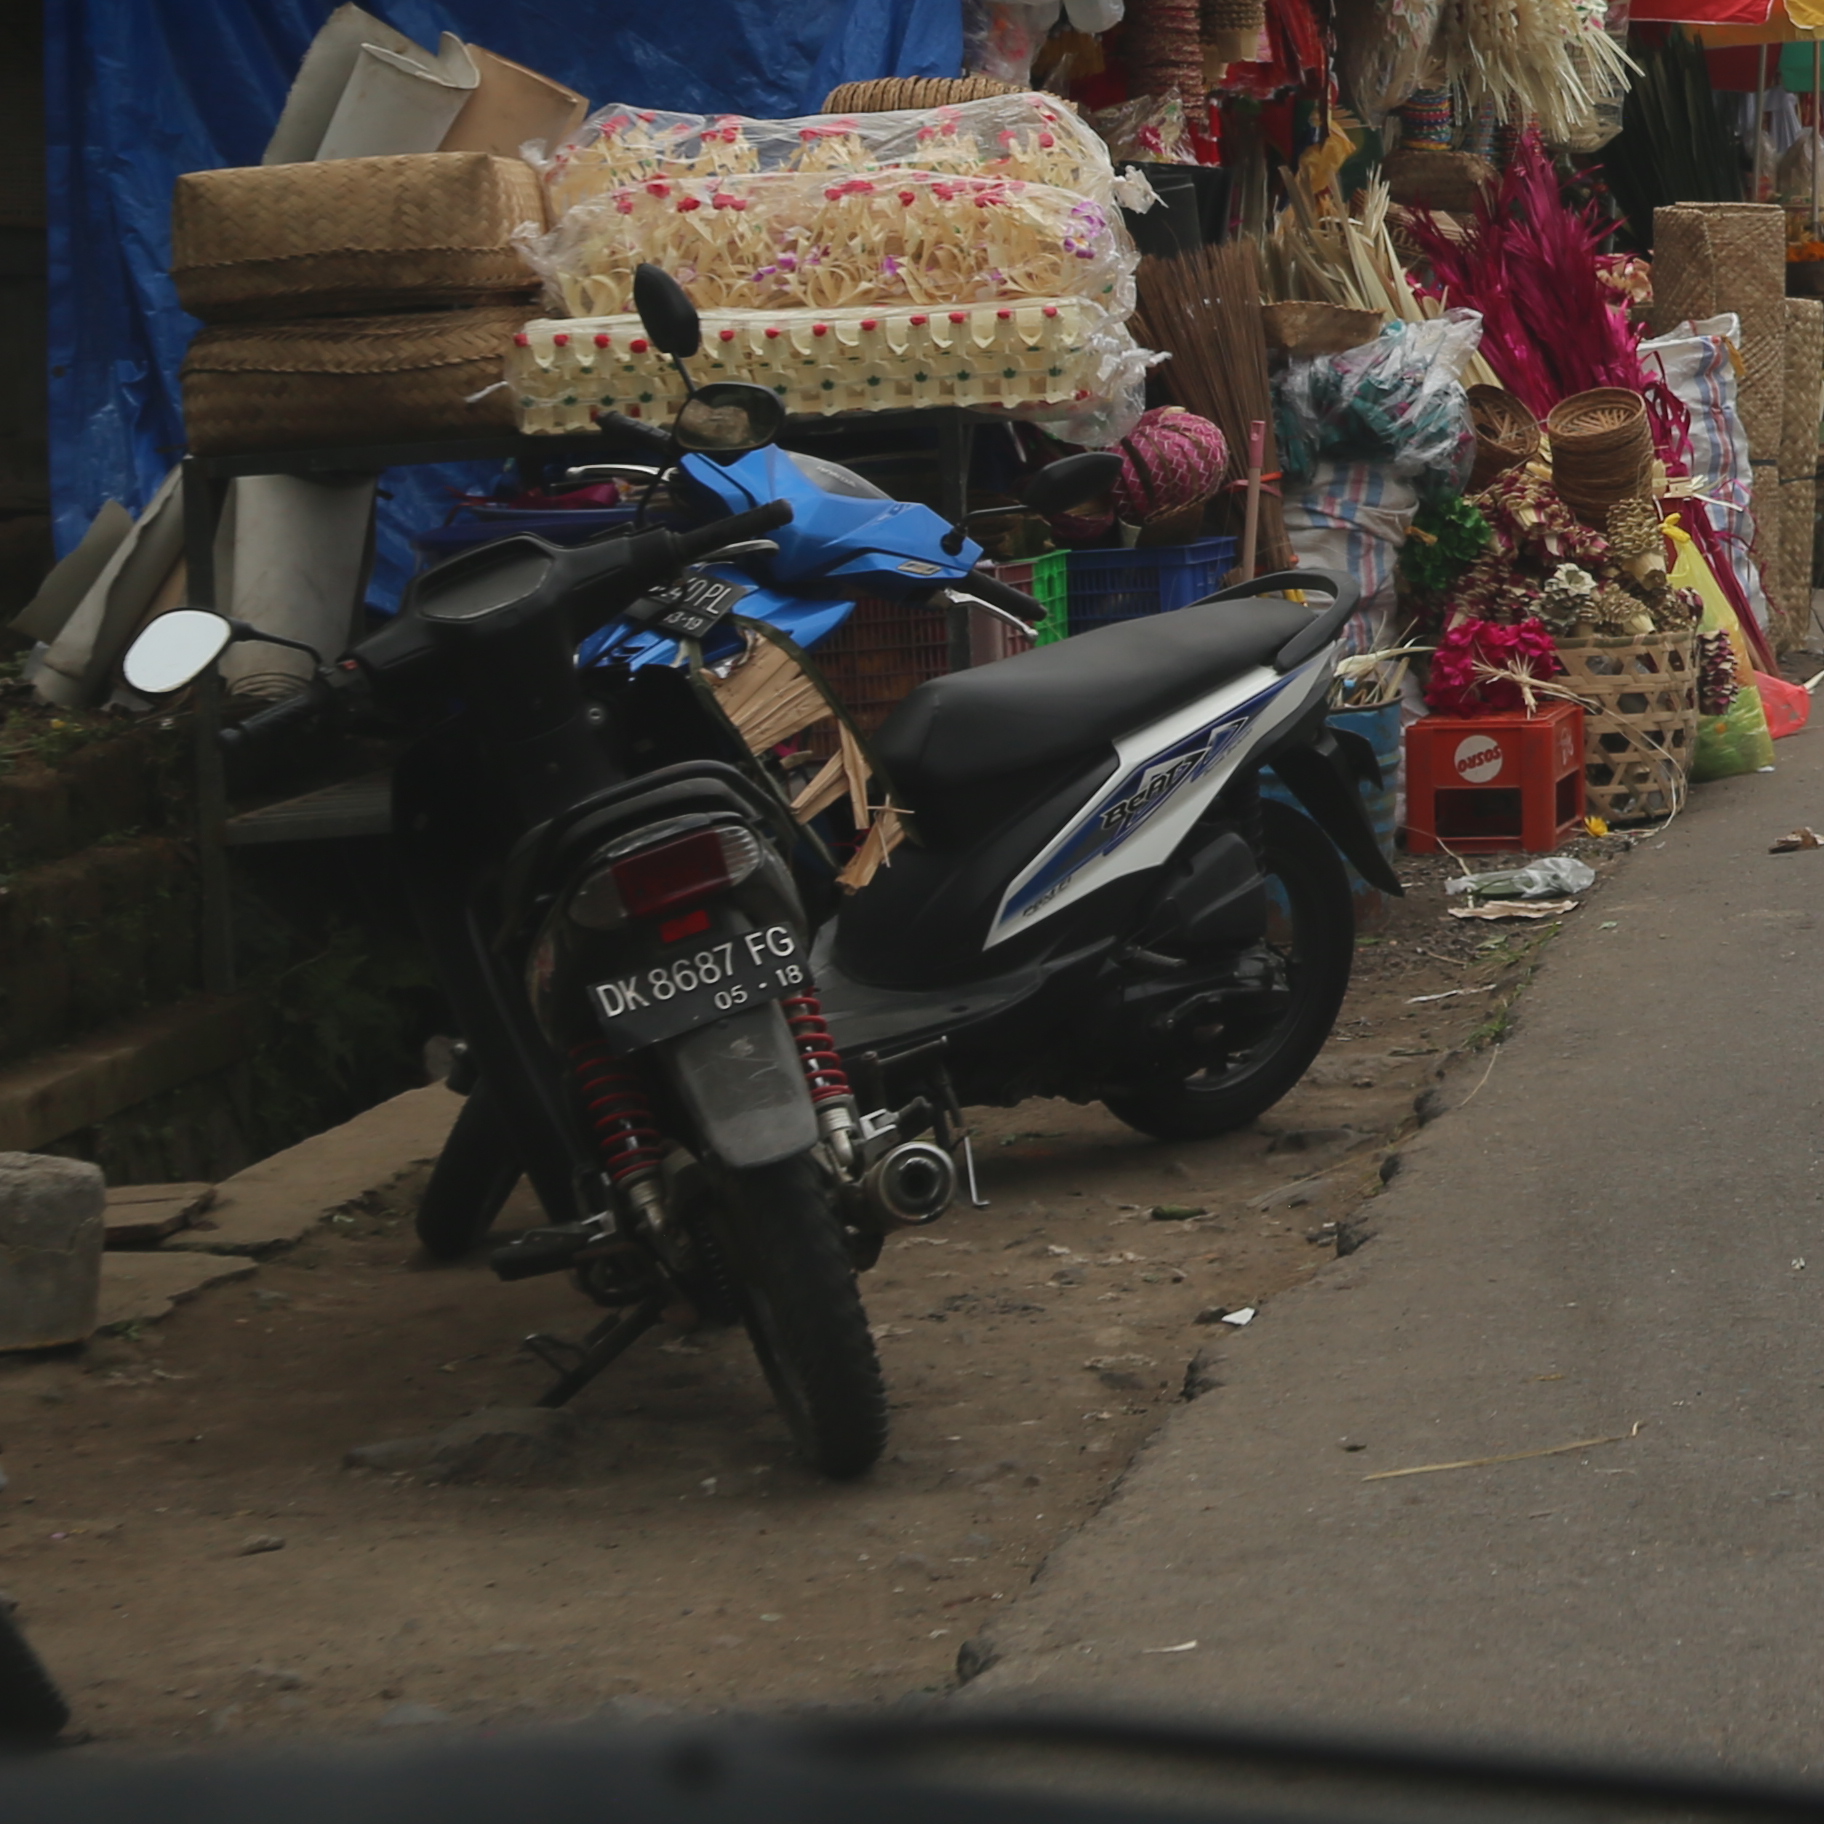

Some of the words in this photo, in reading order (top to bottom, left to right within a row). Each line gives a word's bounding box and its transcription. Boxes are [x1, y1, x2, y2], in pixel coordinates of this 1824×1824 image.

[596, 977, 650, 1018] DK
[648, 941, 733, 1001] 8687
[744, 926, 796, 966] FG
